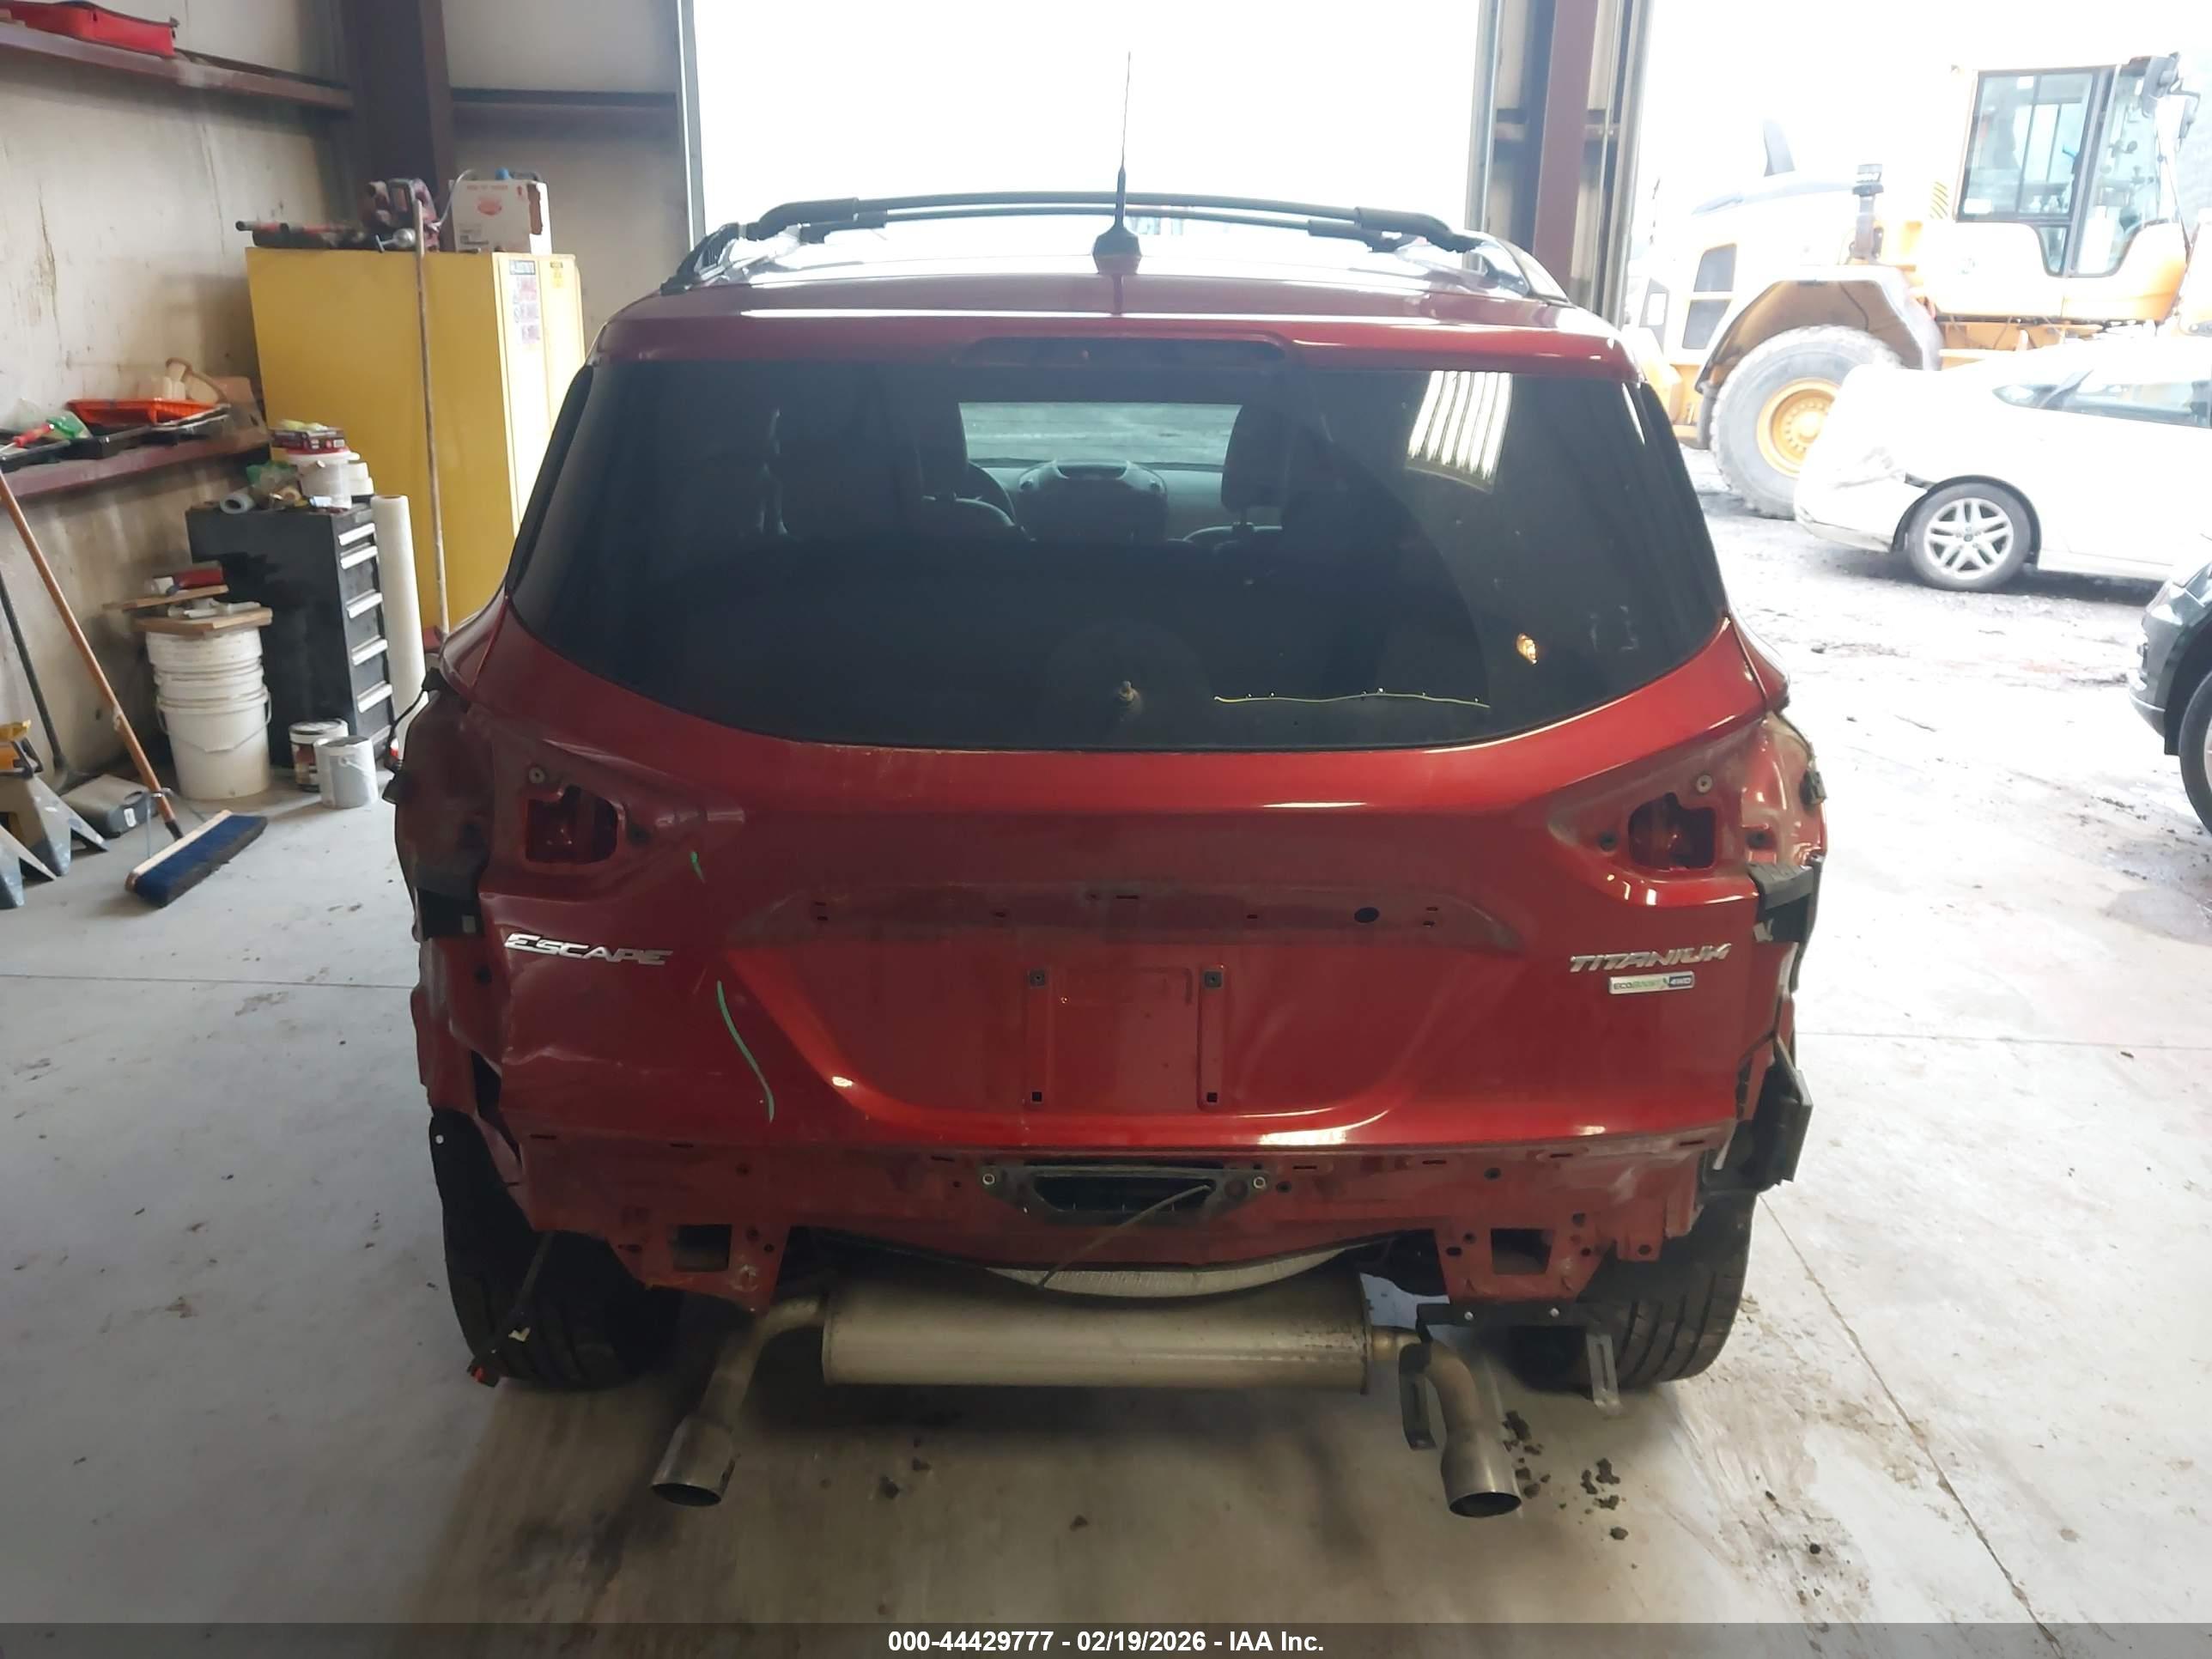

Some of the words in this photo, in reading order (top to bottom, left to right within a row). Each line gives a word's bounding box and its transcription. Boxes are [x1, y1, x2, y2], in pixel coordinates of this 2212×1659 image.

[504, 933, 673, 965] ESCAPE
[1571, 943, 1731, 972] TITANIUM
[1613, 978, 1663, 990] ECOB
